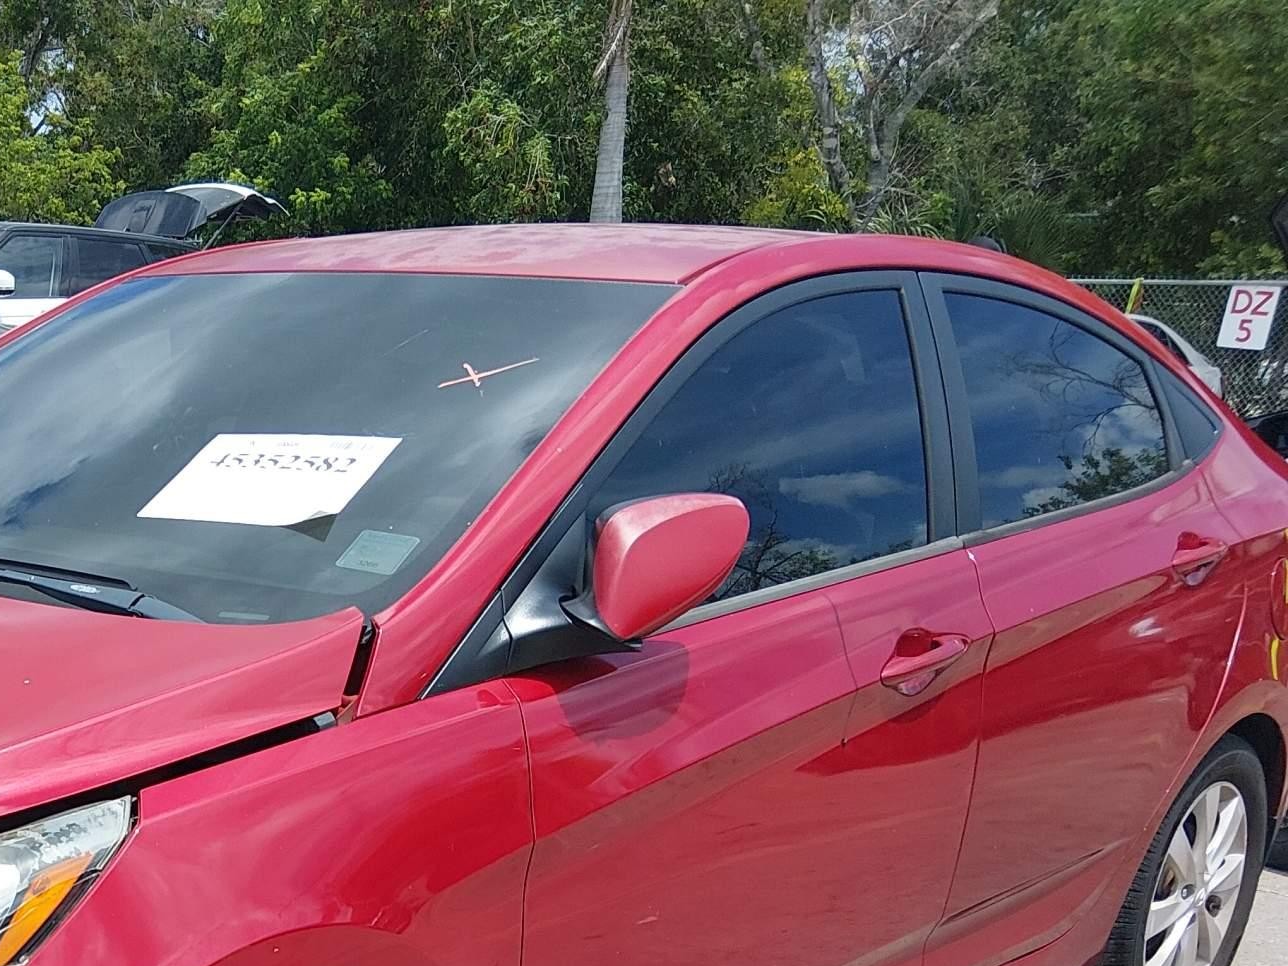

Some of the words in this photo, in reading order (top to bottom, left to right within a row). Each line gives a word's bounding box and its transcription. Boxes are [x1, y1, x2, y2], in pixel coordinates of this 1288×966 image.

[1230, 289, 1274, 316] DZ
[1234, 319, 1253, 343] 5
[210, 452, 357, 473] 45352582
